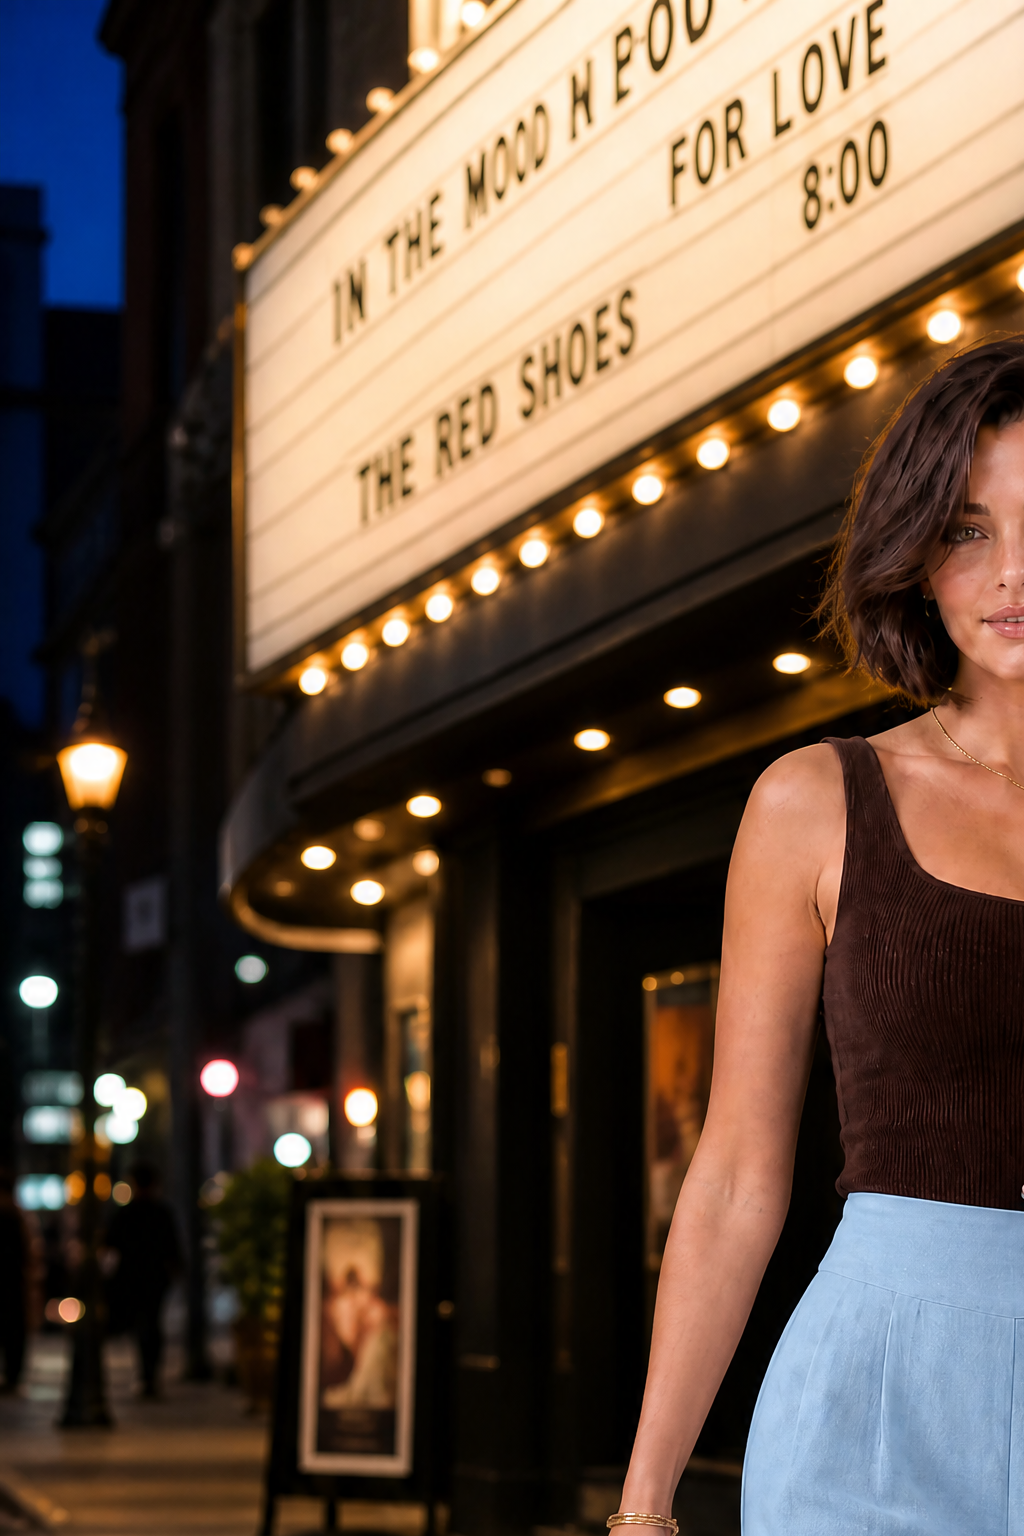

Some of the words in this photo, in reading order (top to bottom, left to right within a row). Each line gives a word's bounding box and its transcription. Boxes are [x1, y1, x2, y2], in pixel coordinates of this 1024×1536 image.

[671, 99, 745, 208] FOR
[773, 0, 886, 138] LOVE
[803, 120, 888, 229] 8:00
[333, 259, 367, 345] IN
[384, 192, 441, 295] THE
[465, 103, 550, 230] MOOD
[356, 433, 414, 526] THE
[435, 384, 498, 478] RED
[519, 289, 637, 418] SHOES
